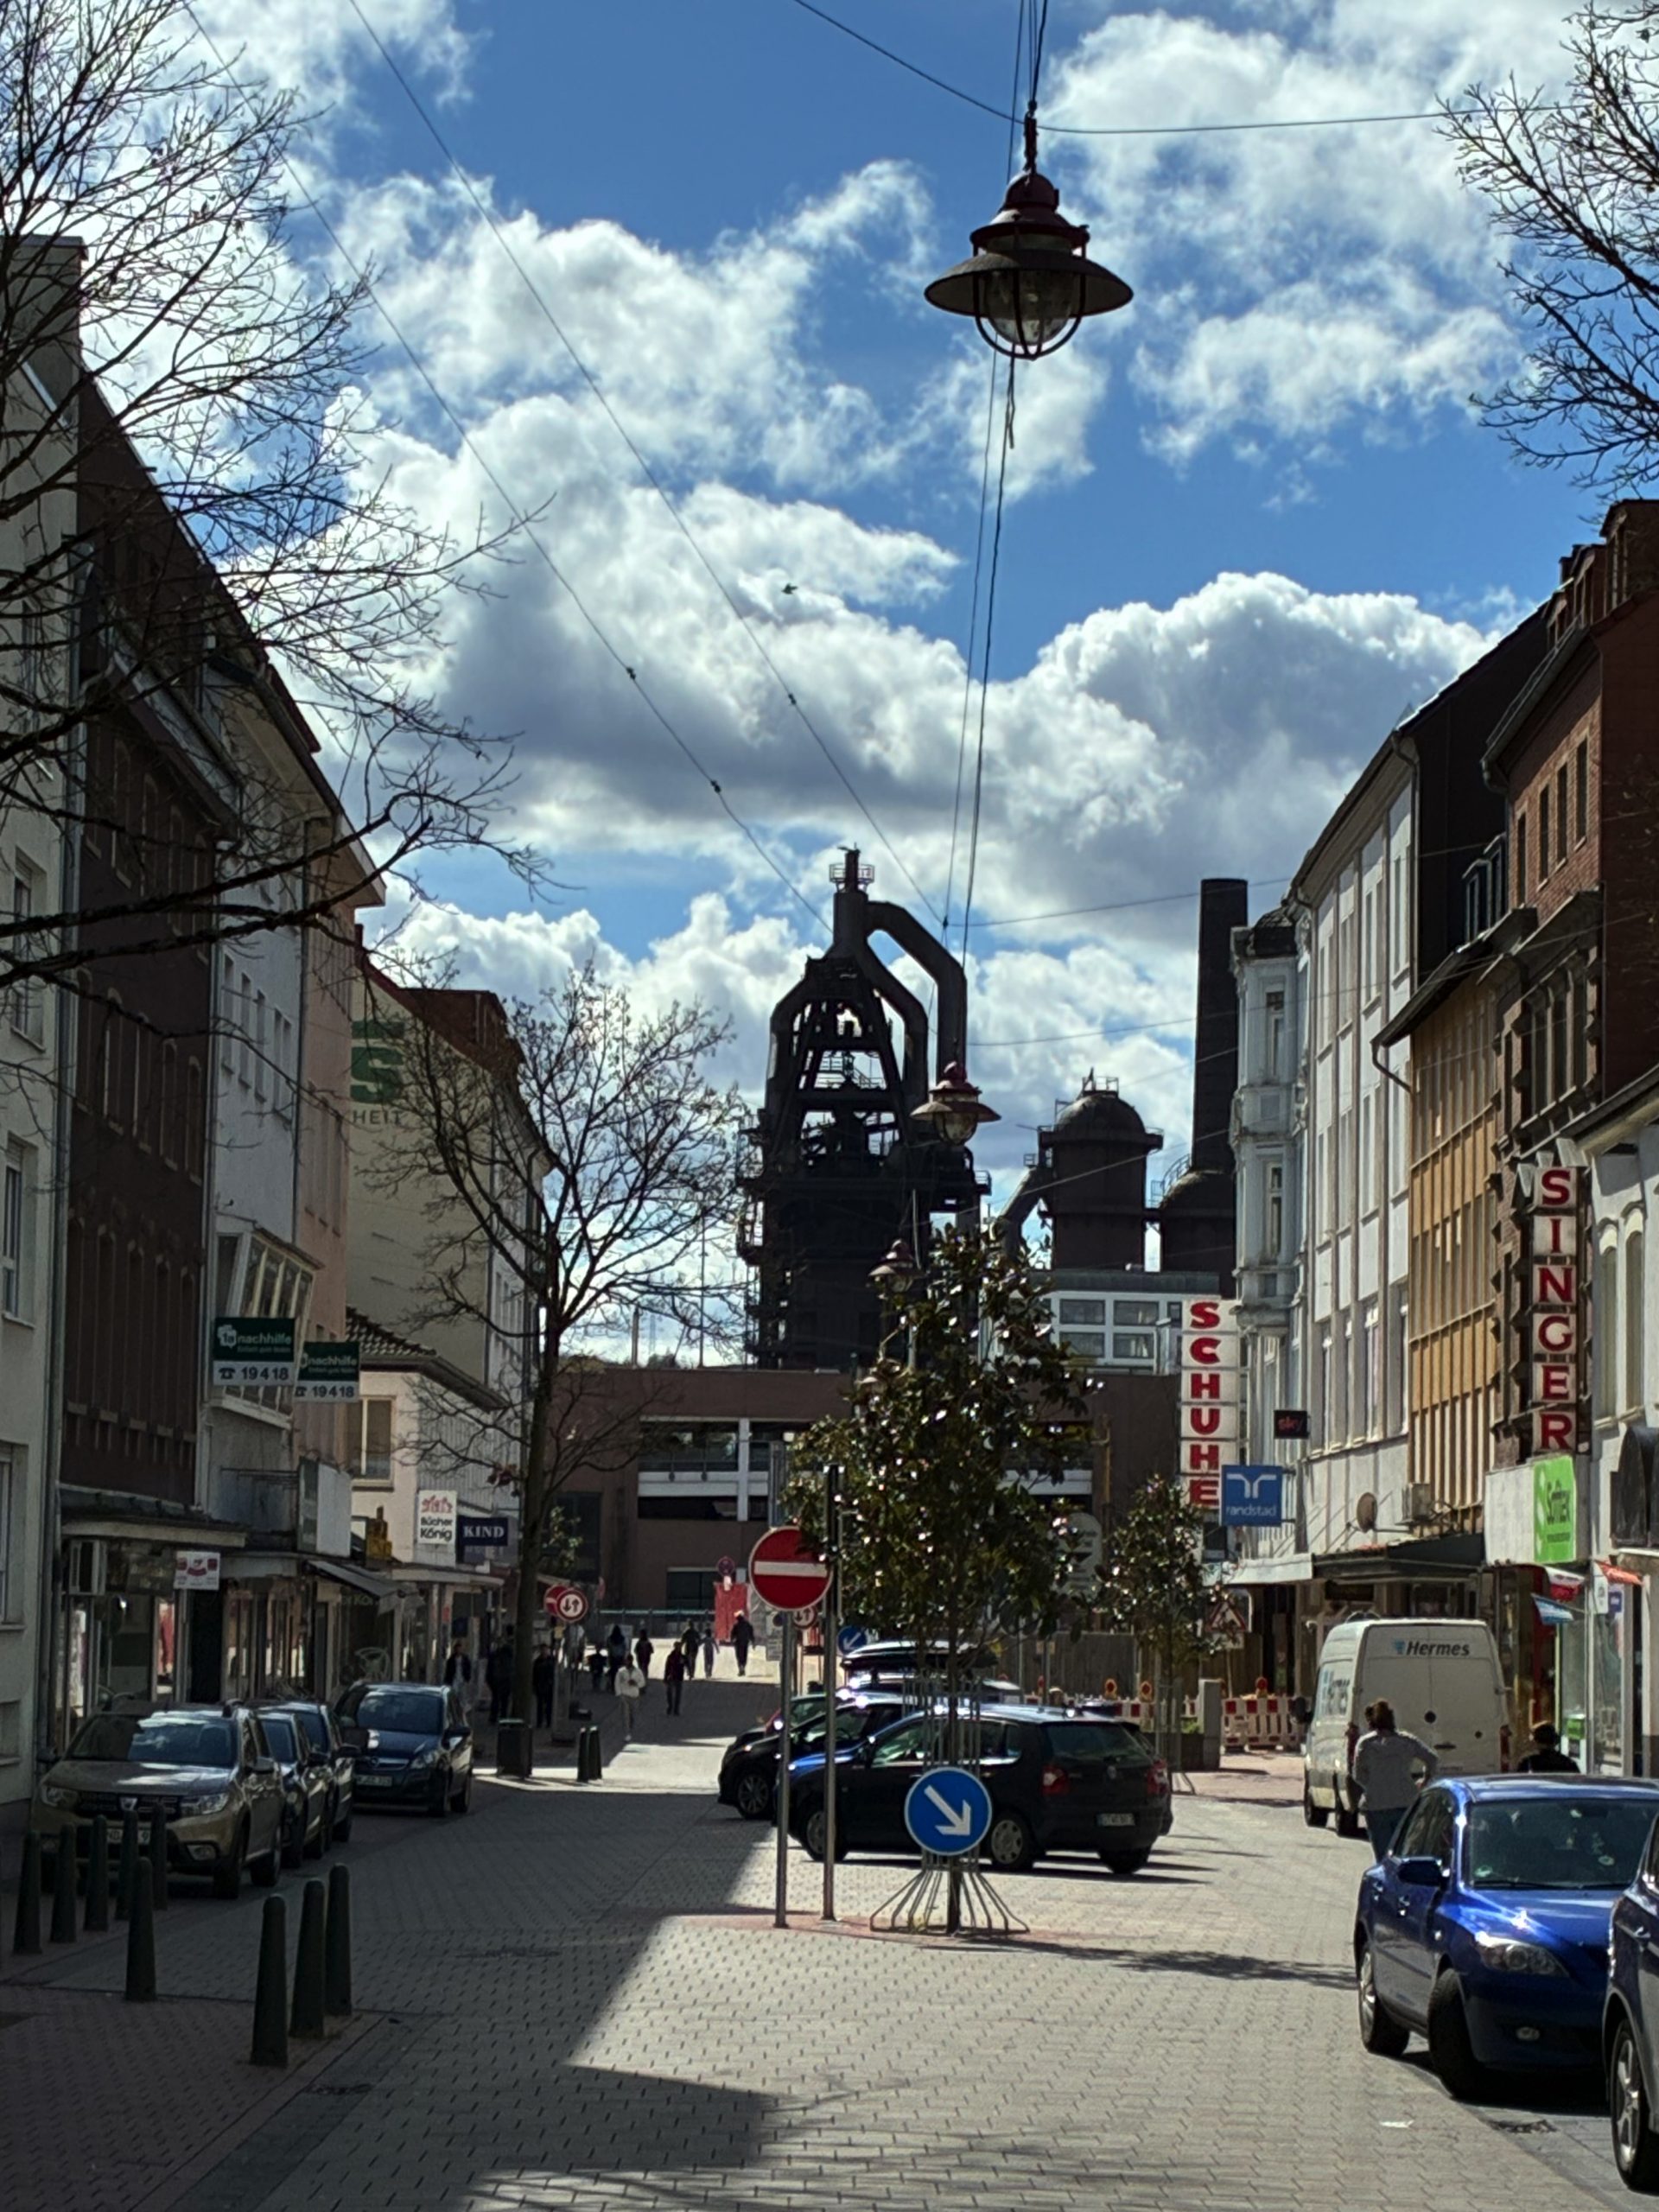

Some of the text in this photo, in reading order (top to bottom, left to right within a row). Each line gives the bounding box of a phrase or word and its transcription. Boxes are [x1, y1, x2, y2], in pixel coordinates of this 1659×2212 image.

[1538, 1169, 1573, 1450] SINGER
[237, 1332, 292, 1345] nachhilfe
[308, 1355, 357, 1367] nachhilfe
[1189, 1301, 1221, 1506] SCHUHE
[1226, 1503, 1277, 1517] randstad
[420, 1516, 453, 1526] Bücher
[420, 1527, 453, 1541] König
[462, 1525, 505, 1538] KIND
[1406, 1640, 1471, 1656] Hermes
